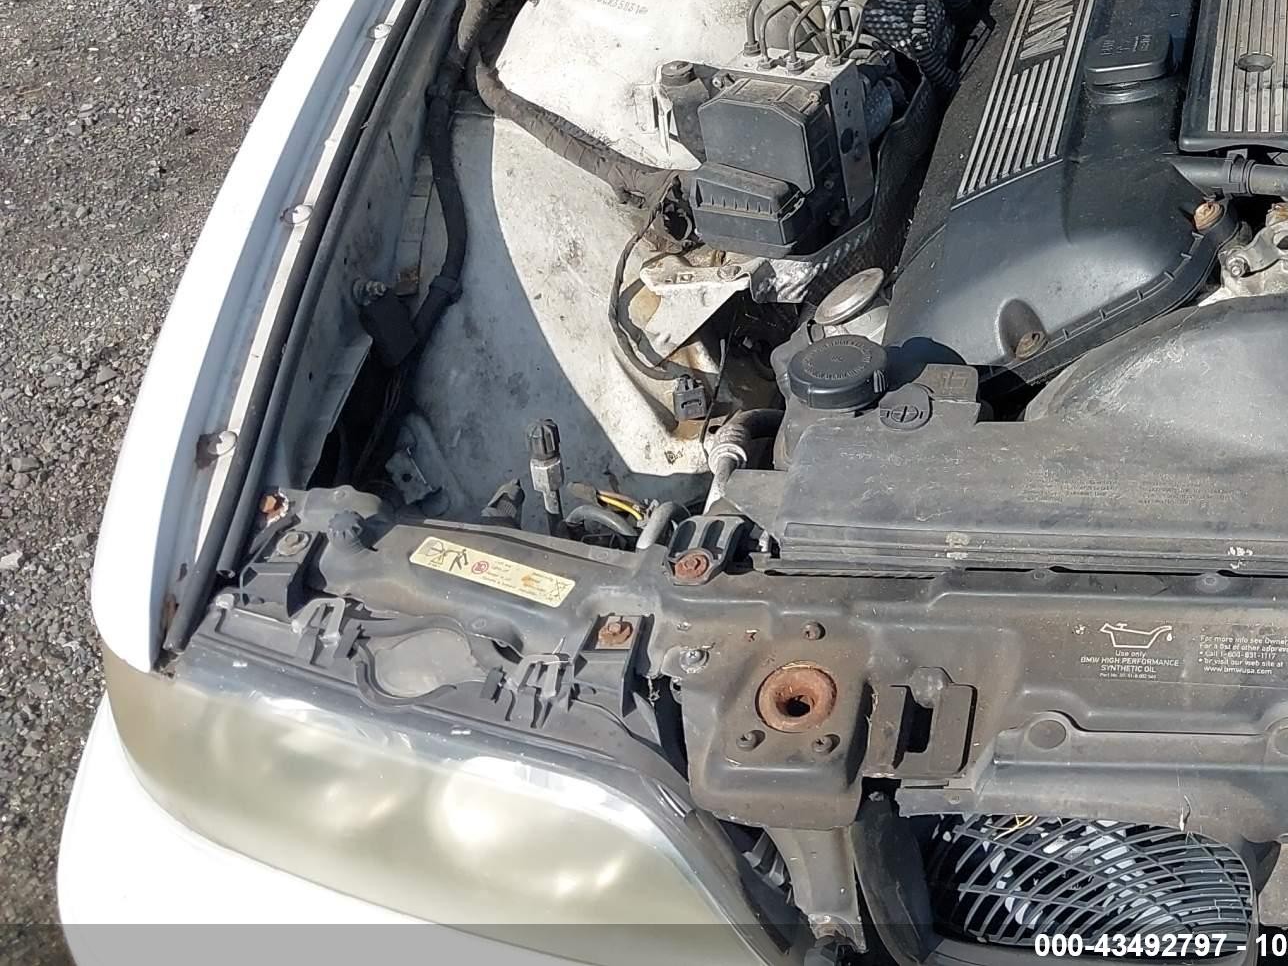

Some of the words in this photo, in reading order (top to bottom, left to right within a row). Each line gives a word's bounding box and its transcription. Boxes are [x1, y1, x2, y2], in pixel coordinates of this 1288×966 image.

[1235, 636, 1249, 644] info
[1241, 644, 1260, 652] other
[1121, 657, 1179, 667] PERFORMANCE
[1100, 664, 1142, 672] SYNTHETIC
[1143, 665, 1157, 673] OIL
